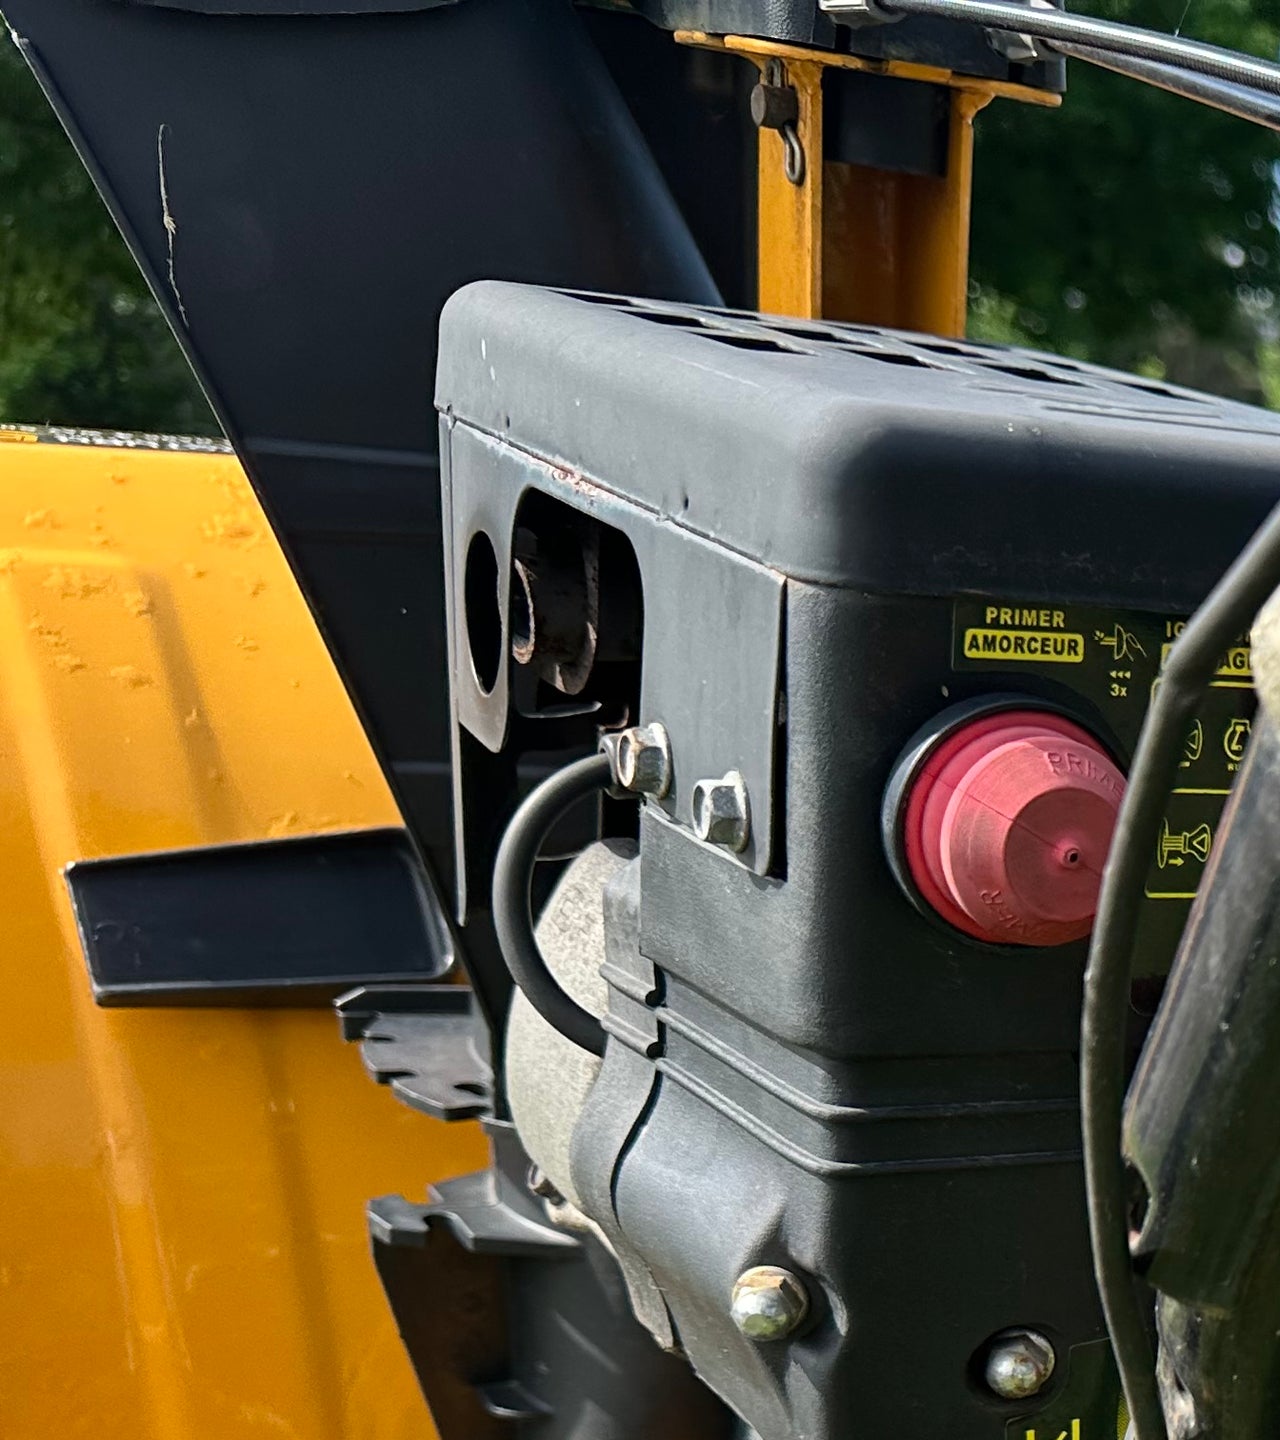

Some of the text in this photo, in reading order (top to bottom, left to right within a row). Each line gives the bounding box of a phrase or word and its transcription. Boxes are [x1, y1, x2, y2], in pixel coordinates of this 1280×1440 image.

[986, 606, 1065, 628] PRIMER
[967, 633, 1080, 657] AMORCEUR
[1110, 683, 1128, 697] 3x
[1043, 751, 1128, 797] PRIME
